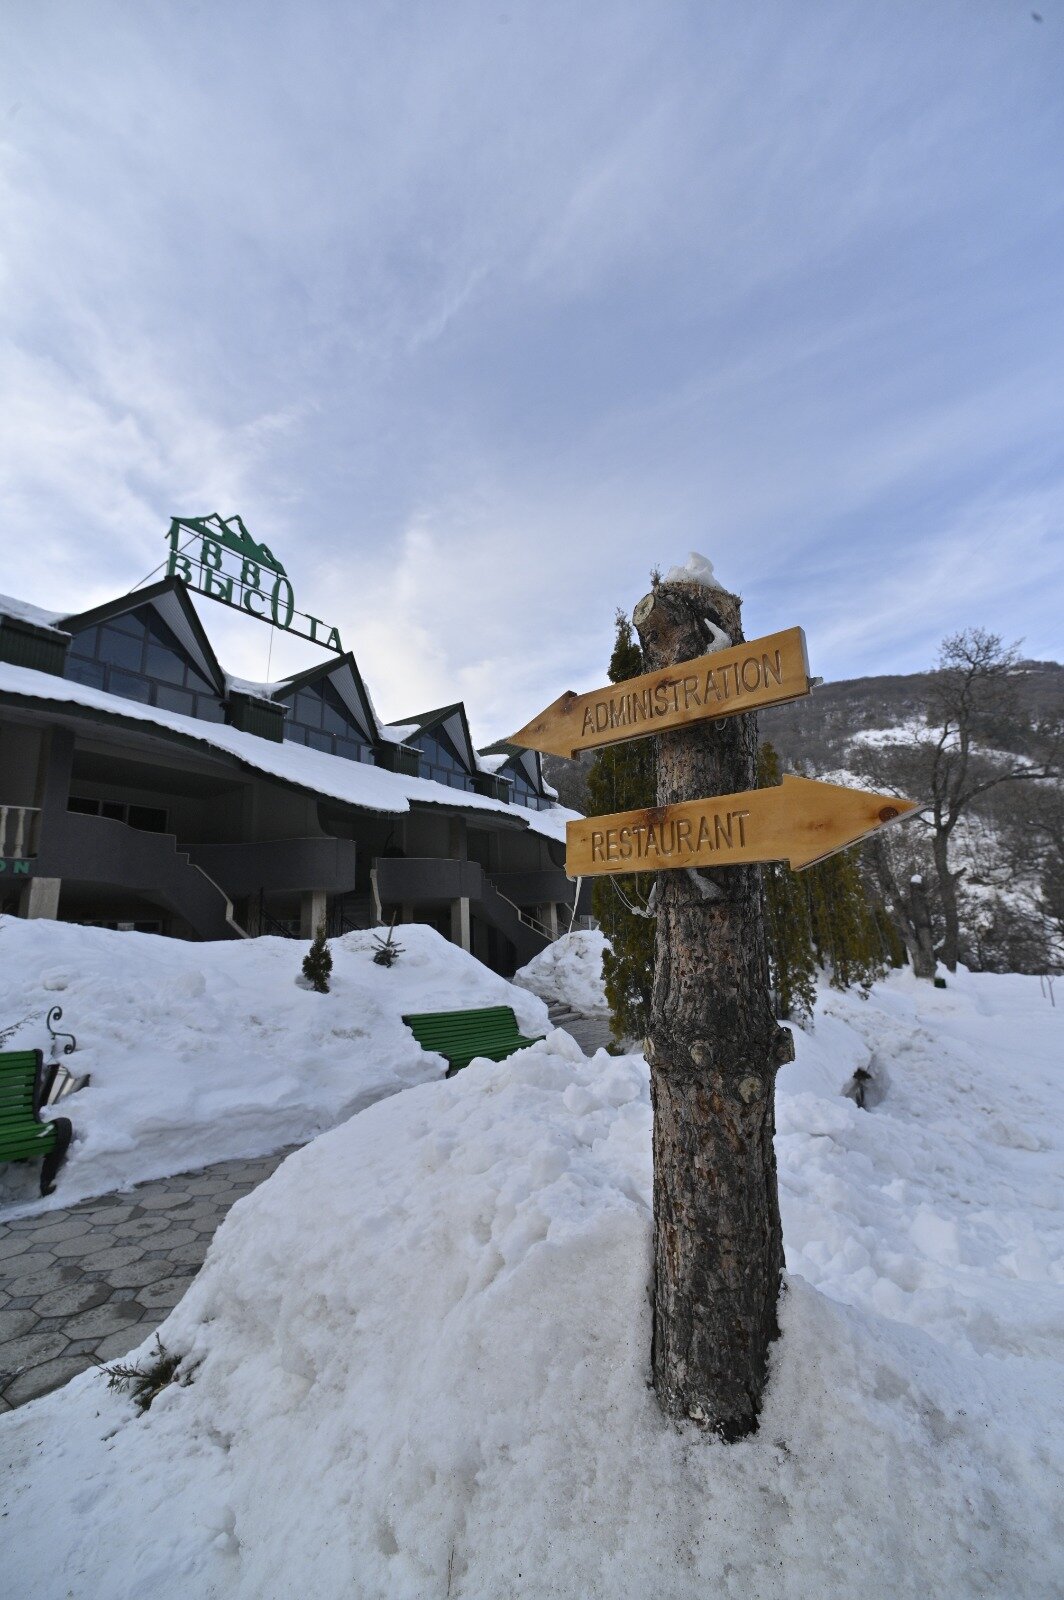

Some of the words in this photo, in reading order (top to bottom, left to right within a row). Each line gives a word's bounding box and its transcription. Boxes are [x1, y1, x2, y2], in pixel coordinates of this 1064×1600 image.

[167, 551, 342, 652] ВЫСОТА
[582, 650, 782, 736] ADMINISTRATION
[592, 810, 750, 862] RESTAURANT
